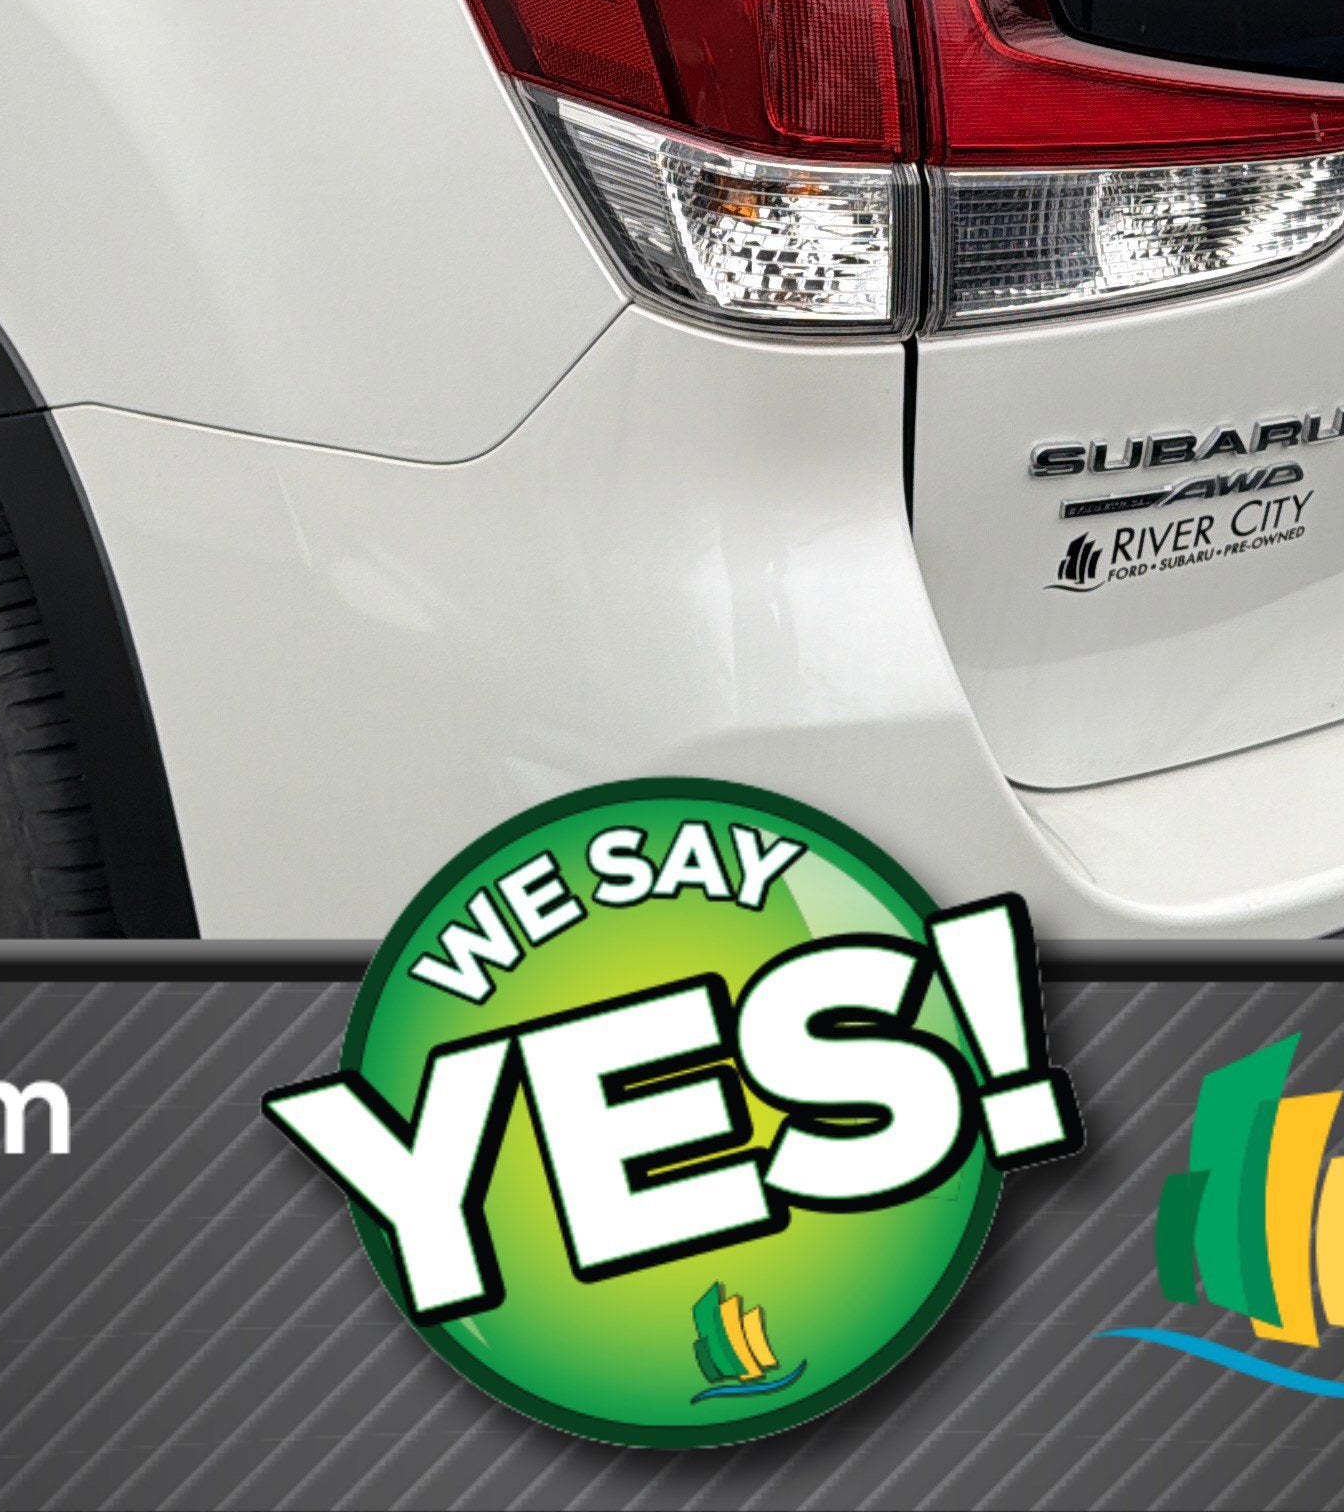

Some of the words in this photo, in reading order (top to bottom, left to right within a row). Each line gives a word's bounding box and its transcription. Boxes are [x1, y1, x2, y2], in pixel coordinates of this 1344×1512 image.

[1158, 459, 1306, 507] AWD
[1107, 562, 1148, 582] FORD
[1158, 547, 1215, 572] SUBARU
[1223, 525, 1306, 557] PRE-OWNED
[1110, 514, 1215, 565] RIVER
[1230, 489, 1315, 538] CITY
